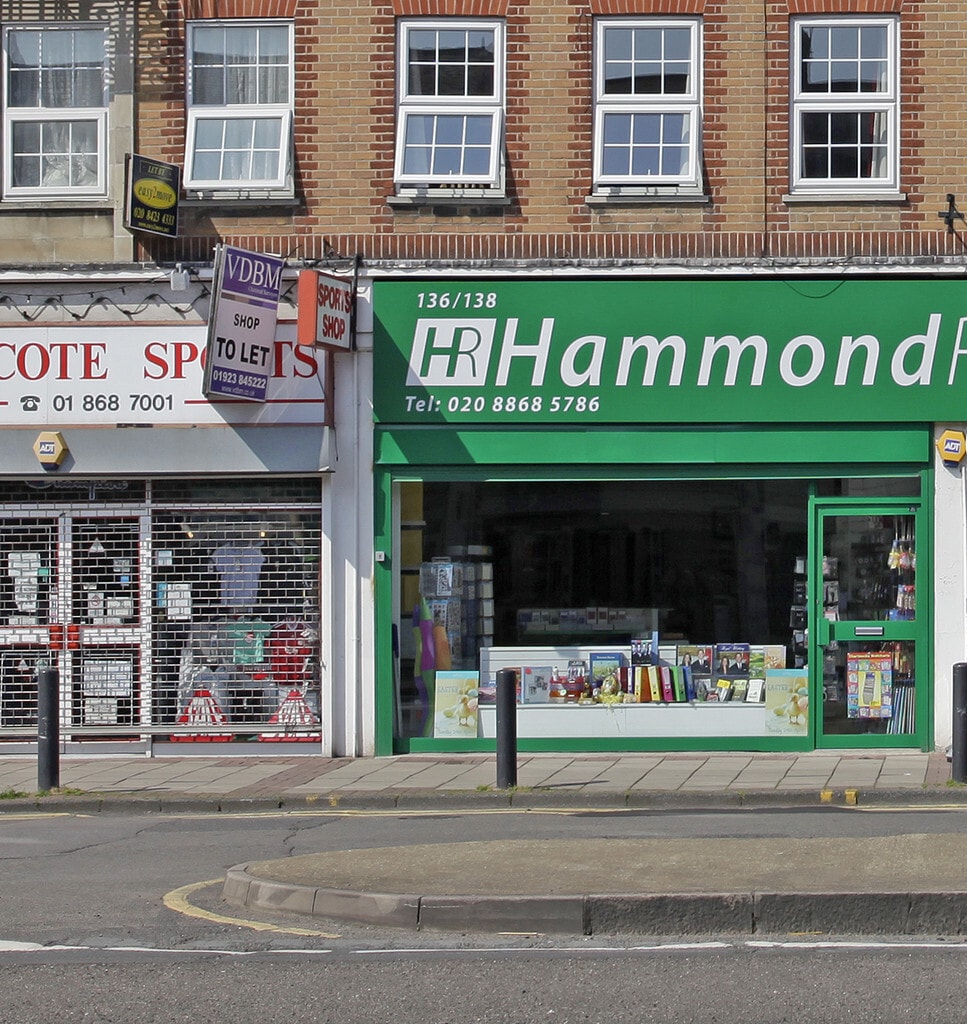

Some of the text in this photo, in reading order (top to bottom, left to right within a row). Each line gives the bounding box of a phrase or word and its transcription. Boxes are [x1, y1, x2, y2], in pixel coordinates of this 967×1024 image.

[133, 207, 145, 219] 020
[227, 253, 281, 291] VDBM
[318, 282, 351, 314] SPORTS
[417, 292, 498, 309] 136/138
[233, 313, 260, 330] SHOP
[322, 314, 346, 340] SHOP
[143, 341, 319, 380] SPTS
[216, 337, 270, 367] TO LET
[213, 369, 267, 389] 01923 845222
[53, 394, 173, 412] 01 868 7001
[405, 395, 600, 412] Tel: 020 8868 5786
[40, 443, 55, 453] ADT
[944, 441, 960, 452] ADT
